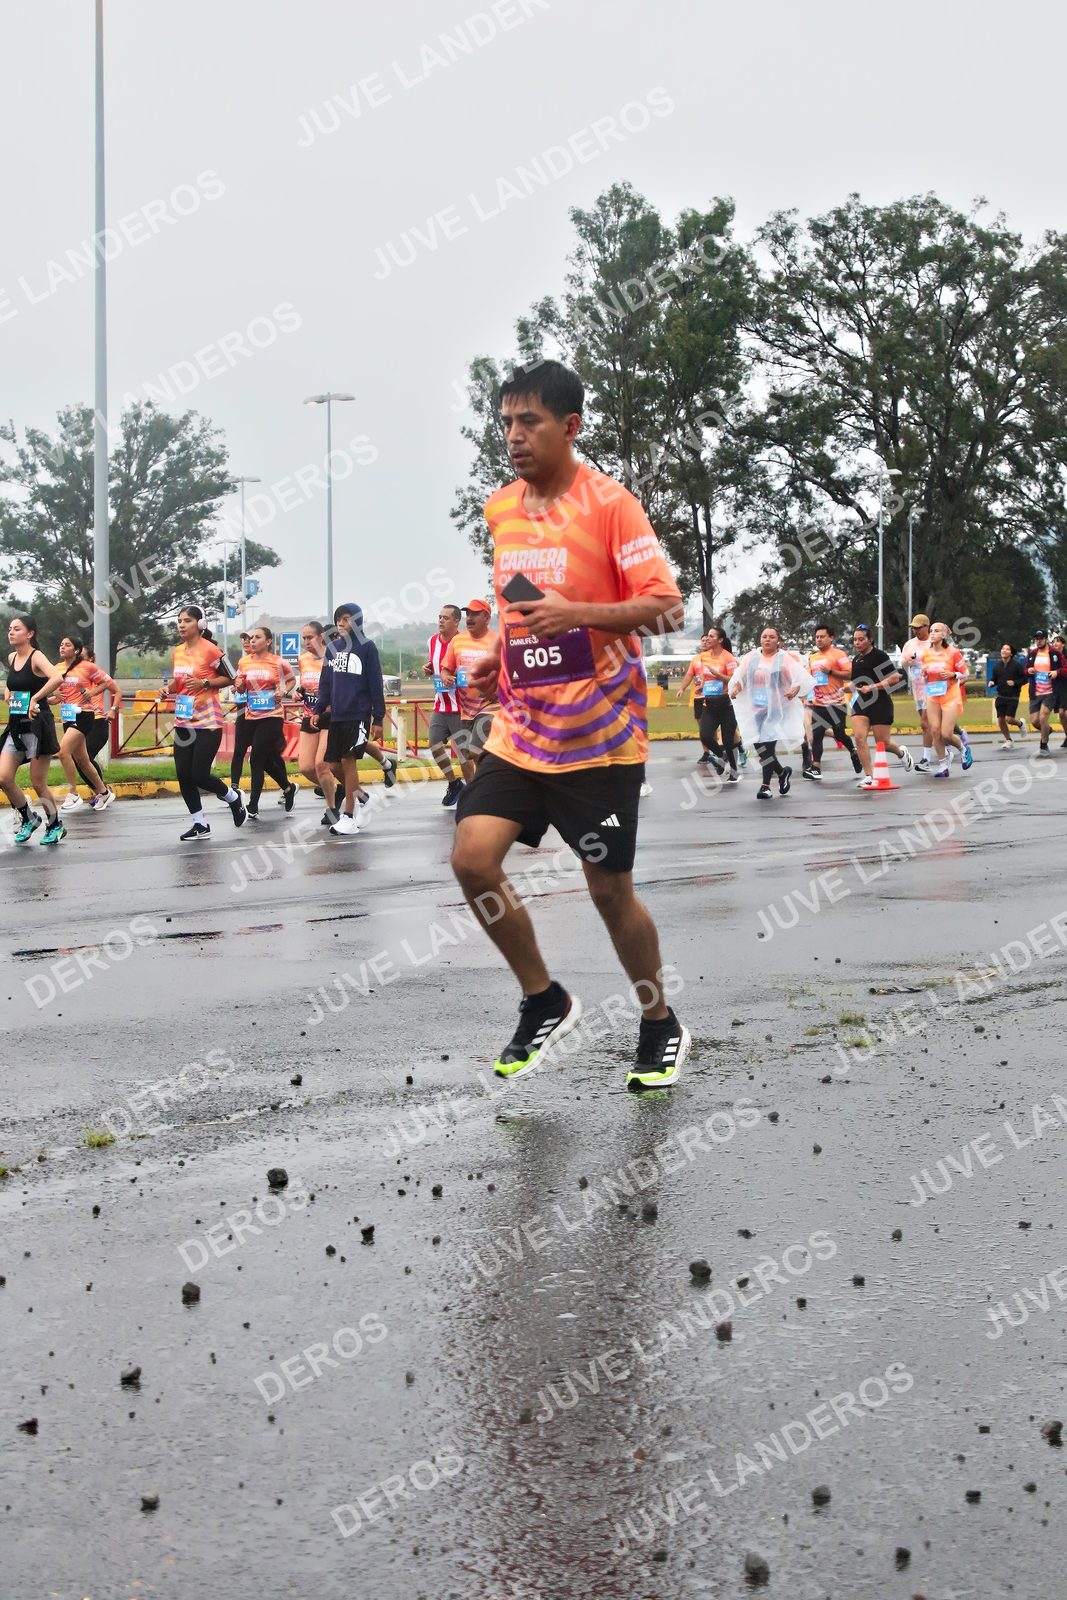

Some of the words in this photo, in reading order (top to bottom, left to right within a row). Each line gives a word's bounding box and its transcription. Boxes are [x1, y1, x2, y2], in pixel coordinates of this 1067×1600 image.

[500, 547, 568, 571] CARRERA
[249, 582, 255, 592] 8
[336, 652, 349, 660] THE
[523, 645, 563, 669] 605
[328, 658, 348, 667] NORTH
[252, 697, 270, 706] 2591
